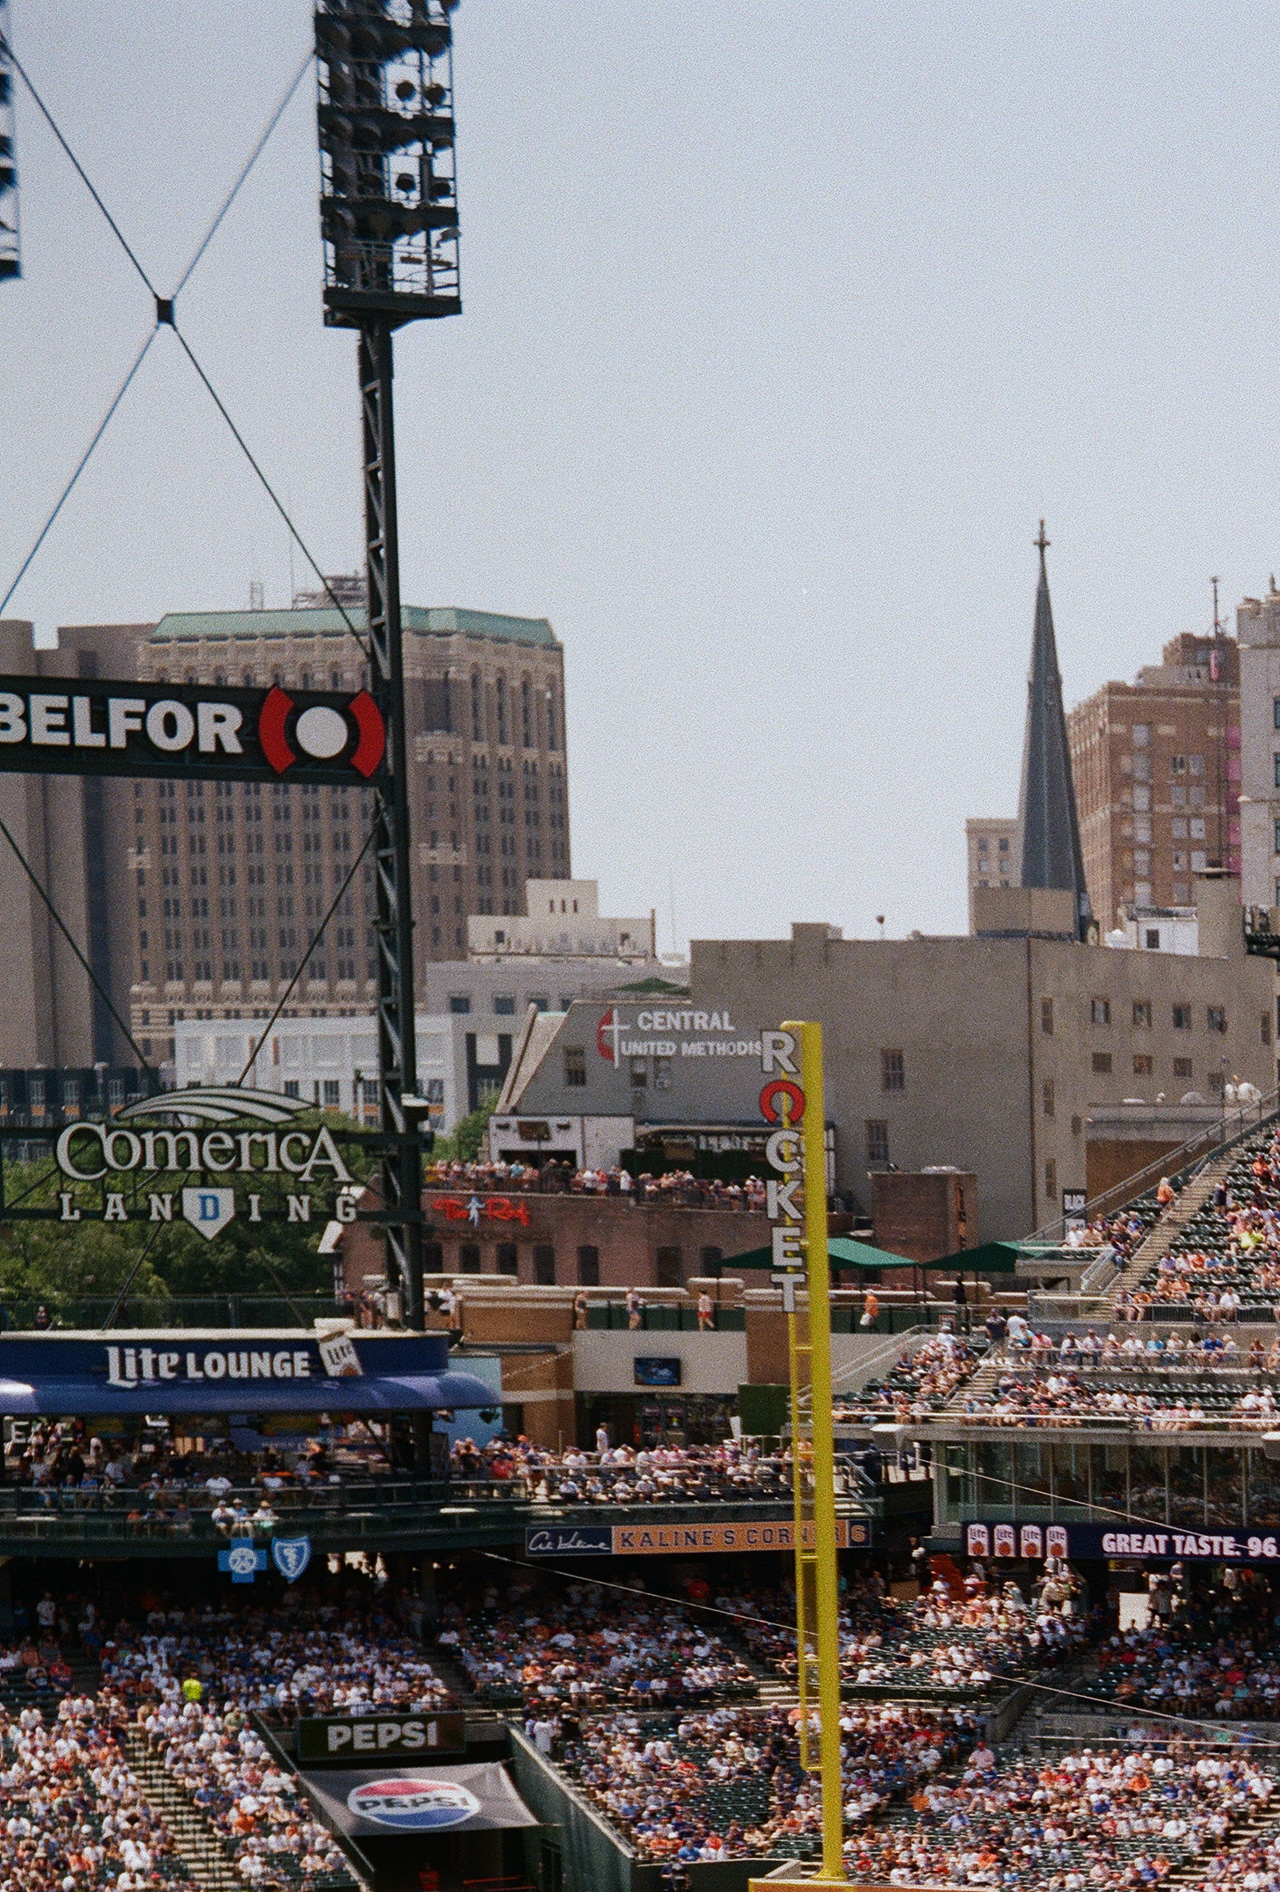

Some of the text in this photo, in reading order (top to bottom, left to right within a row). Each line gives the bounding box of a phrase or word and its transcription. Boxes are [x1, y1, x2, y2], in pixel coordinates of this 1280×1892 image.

[0, 692, 244, 754] BELFOR
[637, 1011, 735, 1032] CENTRAL
[621, 1041, 762, 1057] UNITED METHODIS
[59, 1193, 359, 1223] LANDING
[106, 1346, 310, 1388] Lite LOUNGE
[620, 1530, 736, 1548] KALINE'S
[851, 1525, 870, 1542] 6
[1101, 1532, 1170, 1555] GREAT
[1172, 1534, 1242, 1558] TASTE.
[1247, 1536, 1278, 1557] 96
[327, 1721, 438, 1751] PEPSI
[356, 1796, 470, 1811] PEPSI
